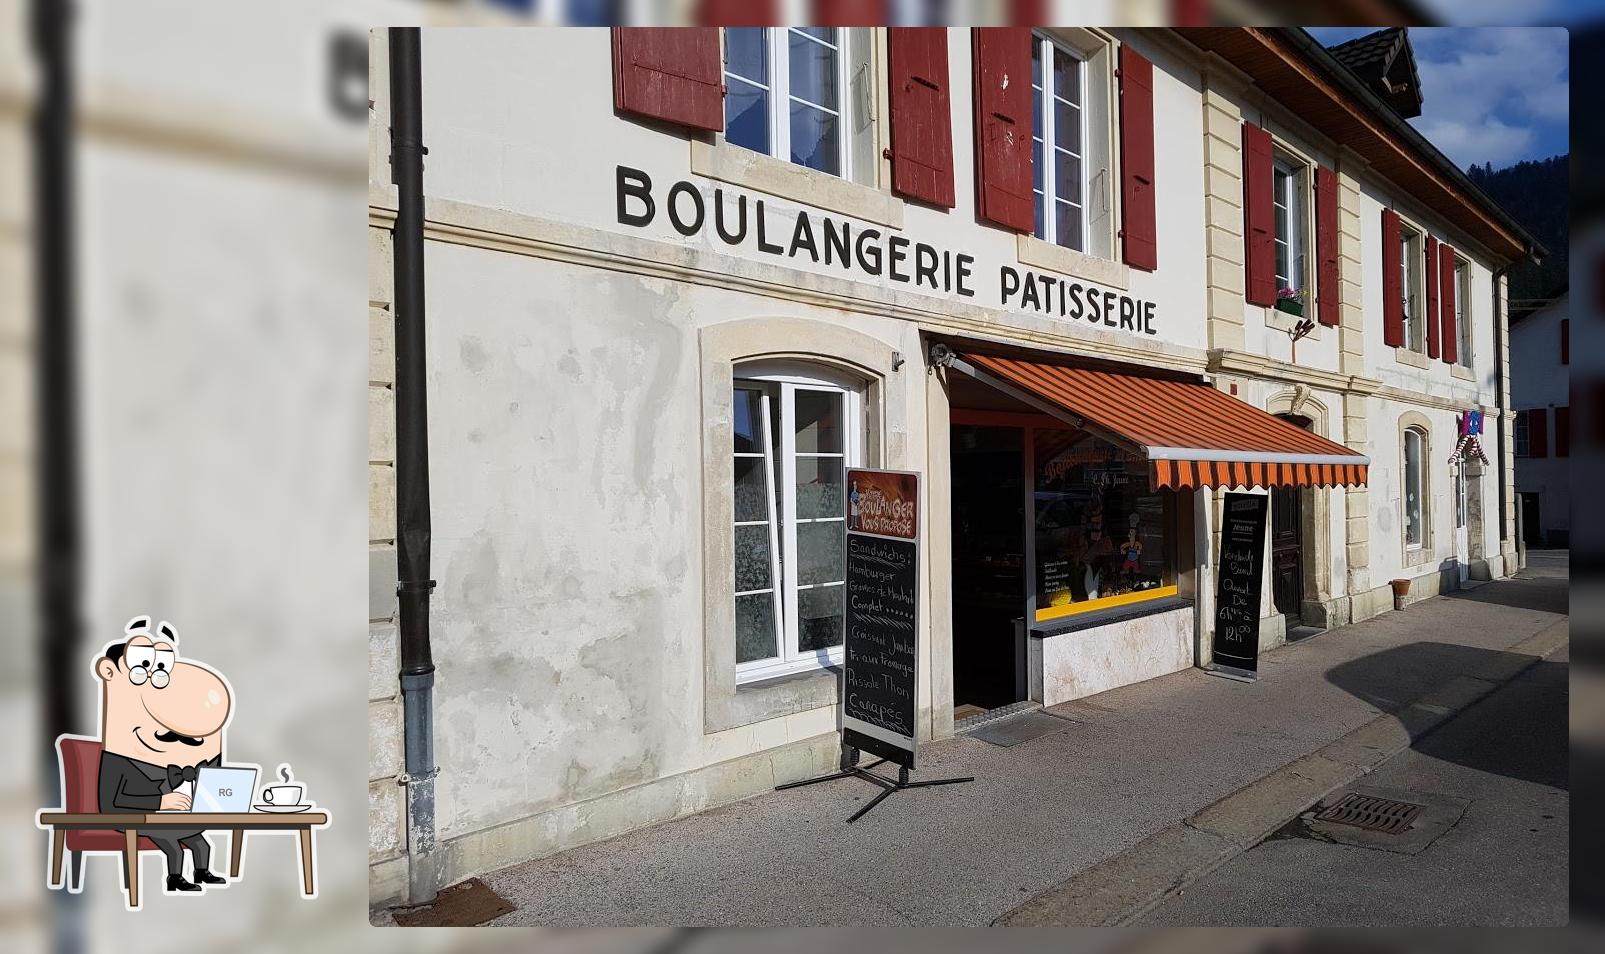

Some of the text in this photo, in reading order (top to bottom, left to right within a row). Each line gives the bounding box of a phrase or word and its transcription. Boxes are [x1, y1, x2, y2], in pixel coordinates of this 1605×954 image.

[616, 165, 1157, 334] BOULANGERIE PATISSERIE
[859, 497, 914, 519] BOULANGER
[849, 561, 896, 582] Hamburger
[881, 673, 910, 700] Thon
